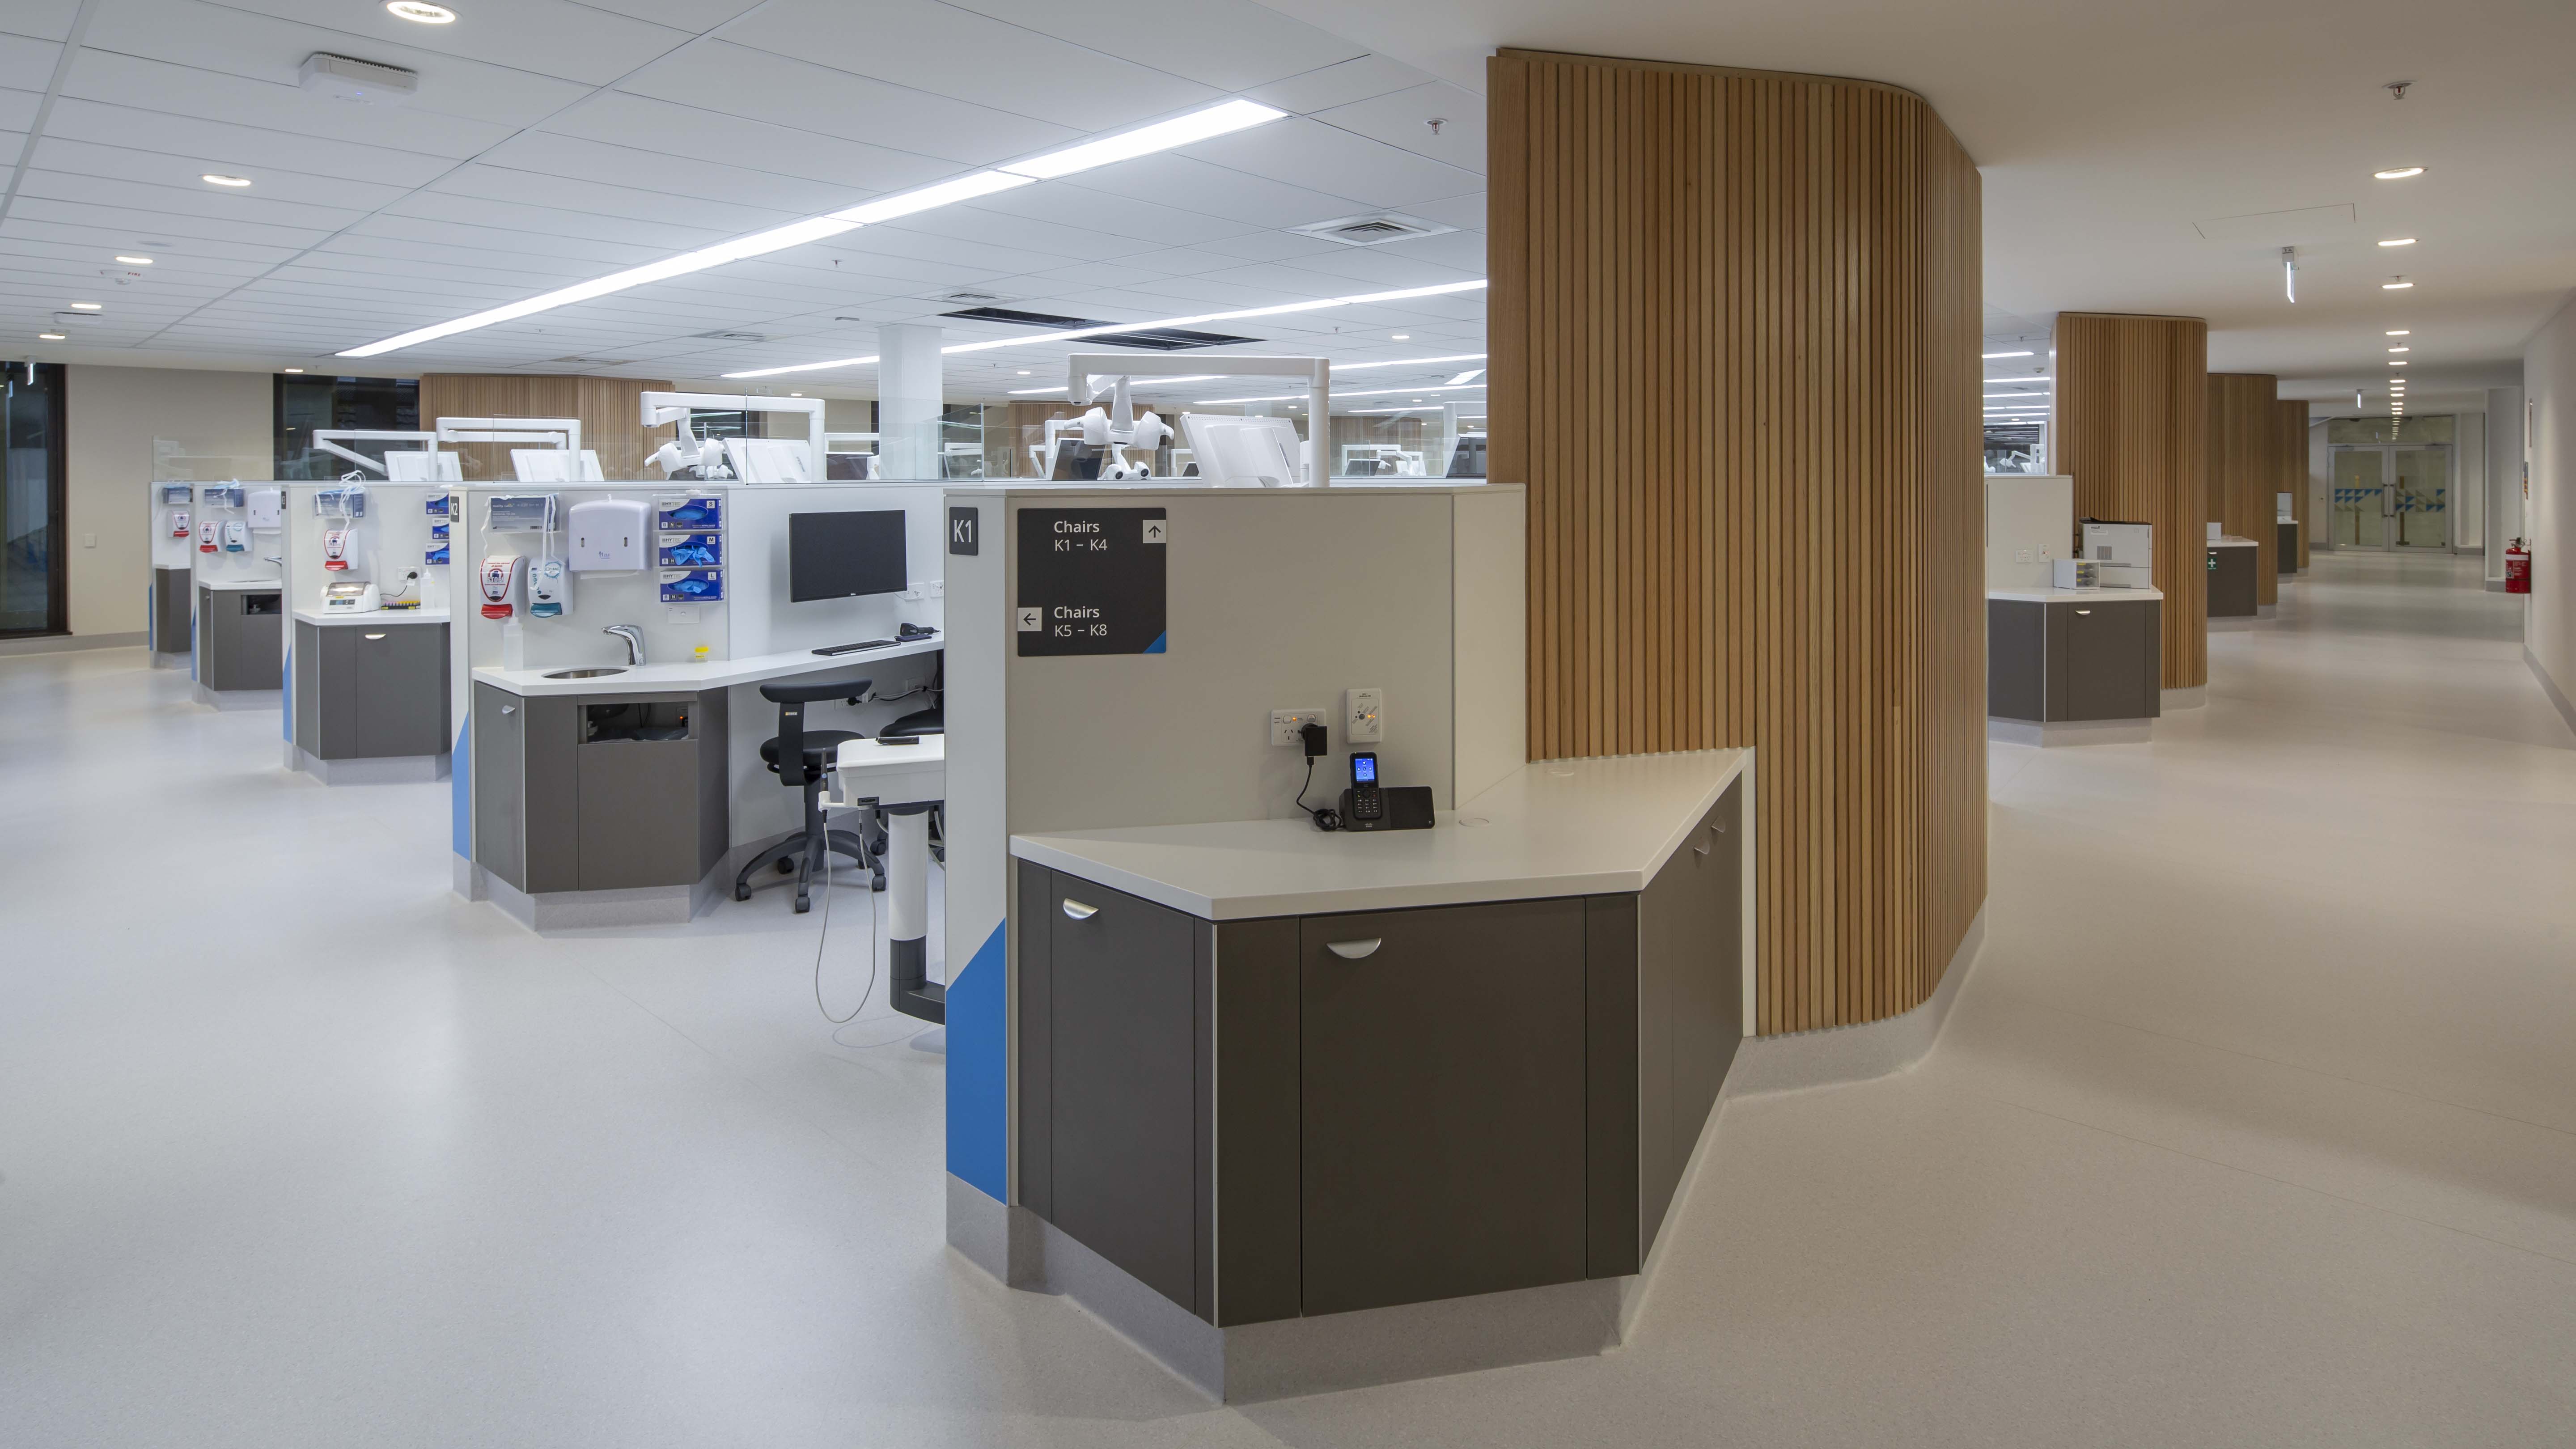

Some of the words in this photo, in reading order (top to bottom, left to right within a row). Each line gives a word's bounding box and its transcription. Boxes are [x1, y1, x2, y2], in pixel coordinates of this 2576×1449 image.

[451, 503, 458, 515] K2
[954, 520, 971, 542] K1
[1054, 521, 1100, 533] Chairs
[1055, 539, 1069, 551] K1
[1090, 539, 1107, 551] K4
[1054, 606, 1100, 618] Chairs
[1055, 625, 1072, 636] K5
[1090, 624, 1107, 636] K8
